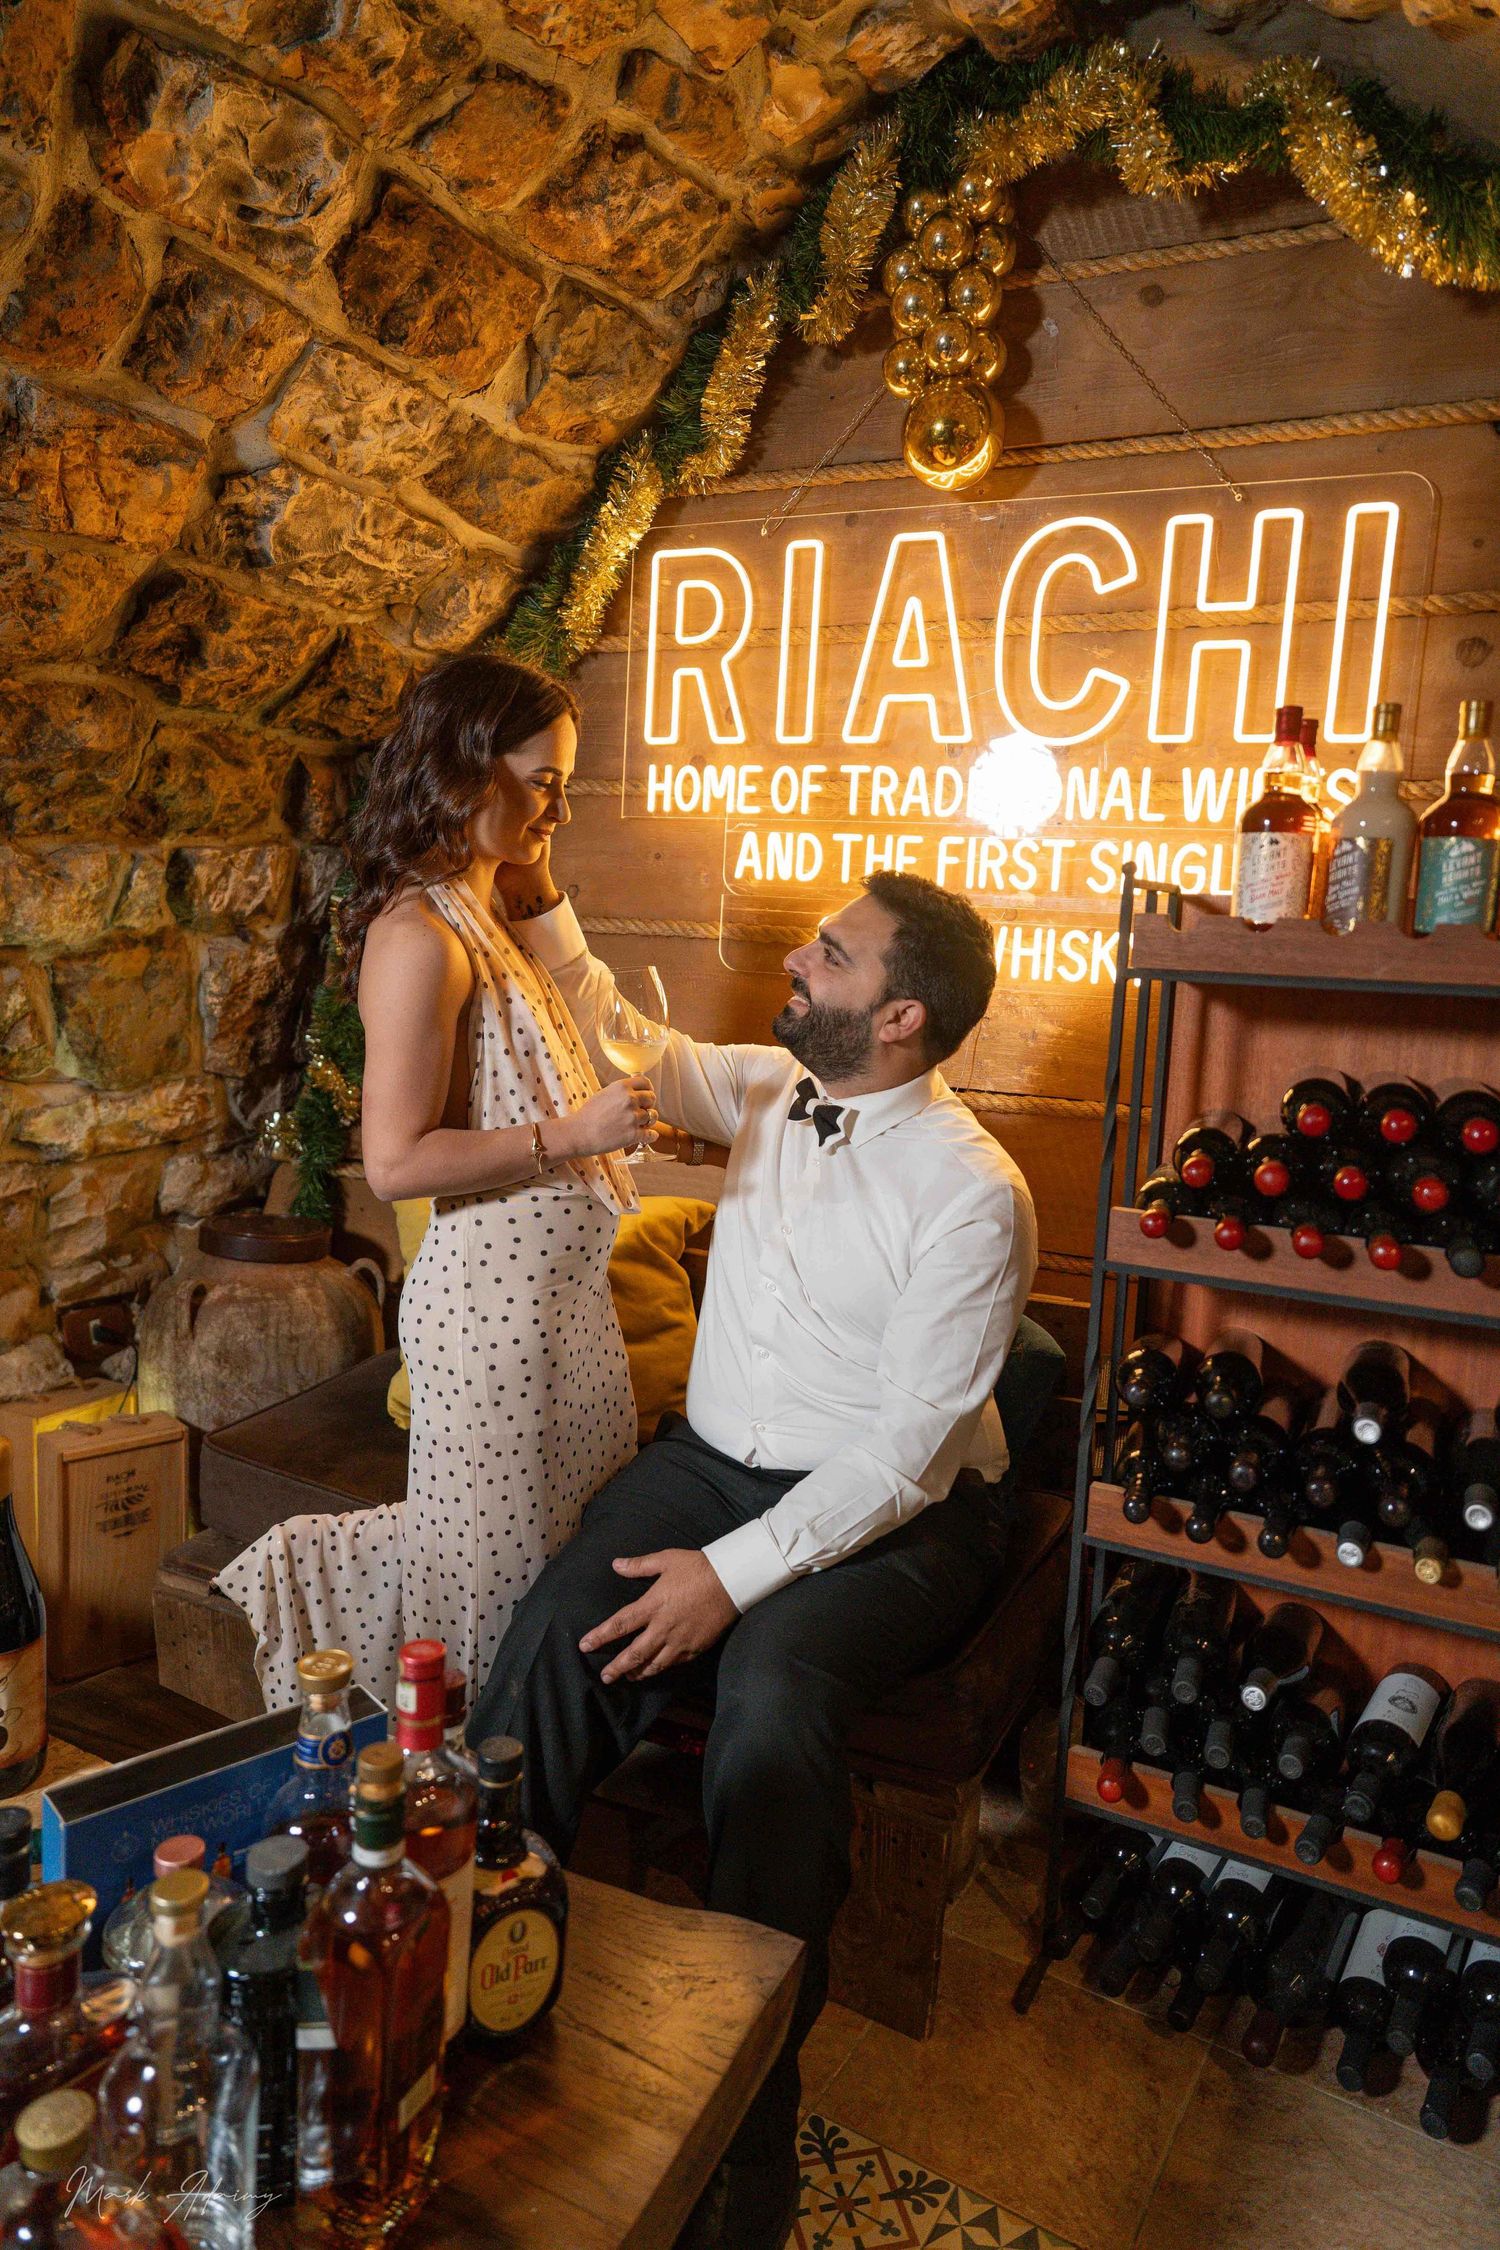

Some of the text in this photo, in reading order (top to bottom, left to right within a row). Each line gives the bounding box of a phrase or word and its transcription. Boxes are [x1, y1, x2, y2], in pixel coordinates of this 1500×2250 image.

[643, 502, 1400, 744] RIACHI
[647, 764, 763, 814] HOME
[770, 765, 827, 815] OF
[734, 831, 823, 882] AND
[832, 833, 924, 884] THE
[936, 835, 1076, 893] FIRST
[481, 1962, 511, 1990] Old
[512, 1953, 548, 1981] Parr
